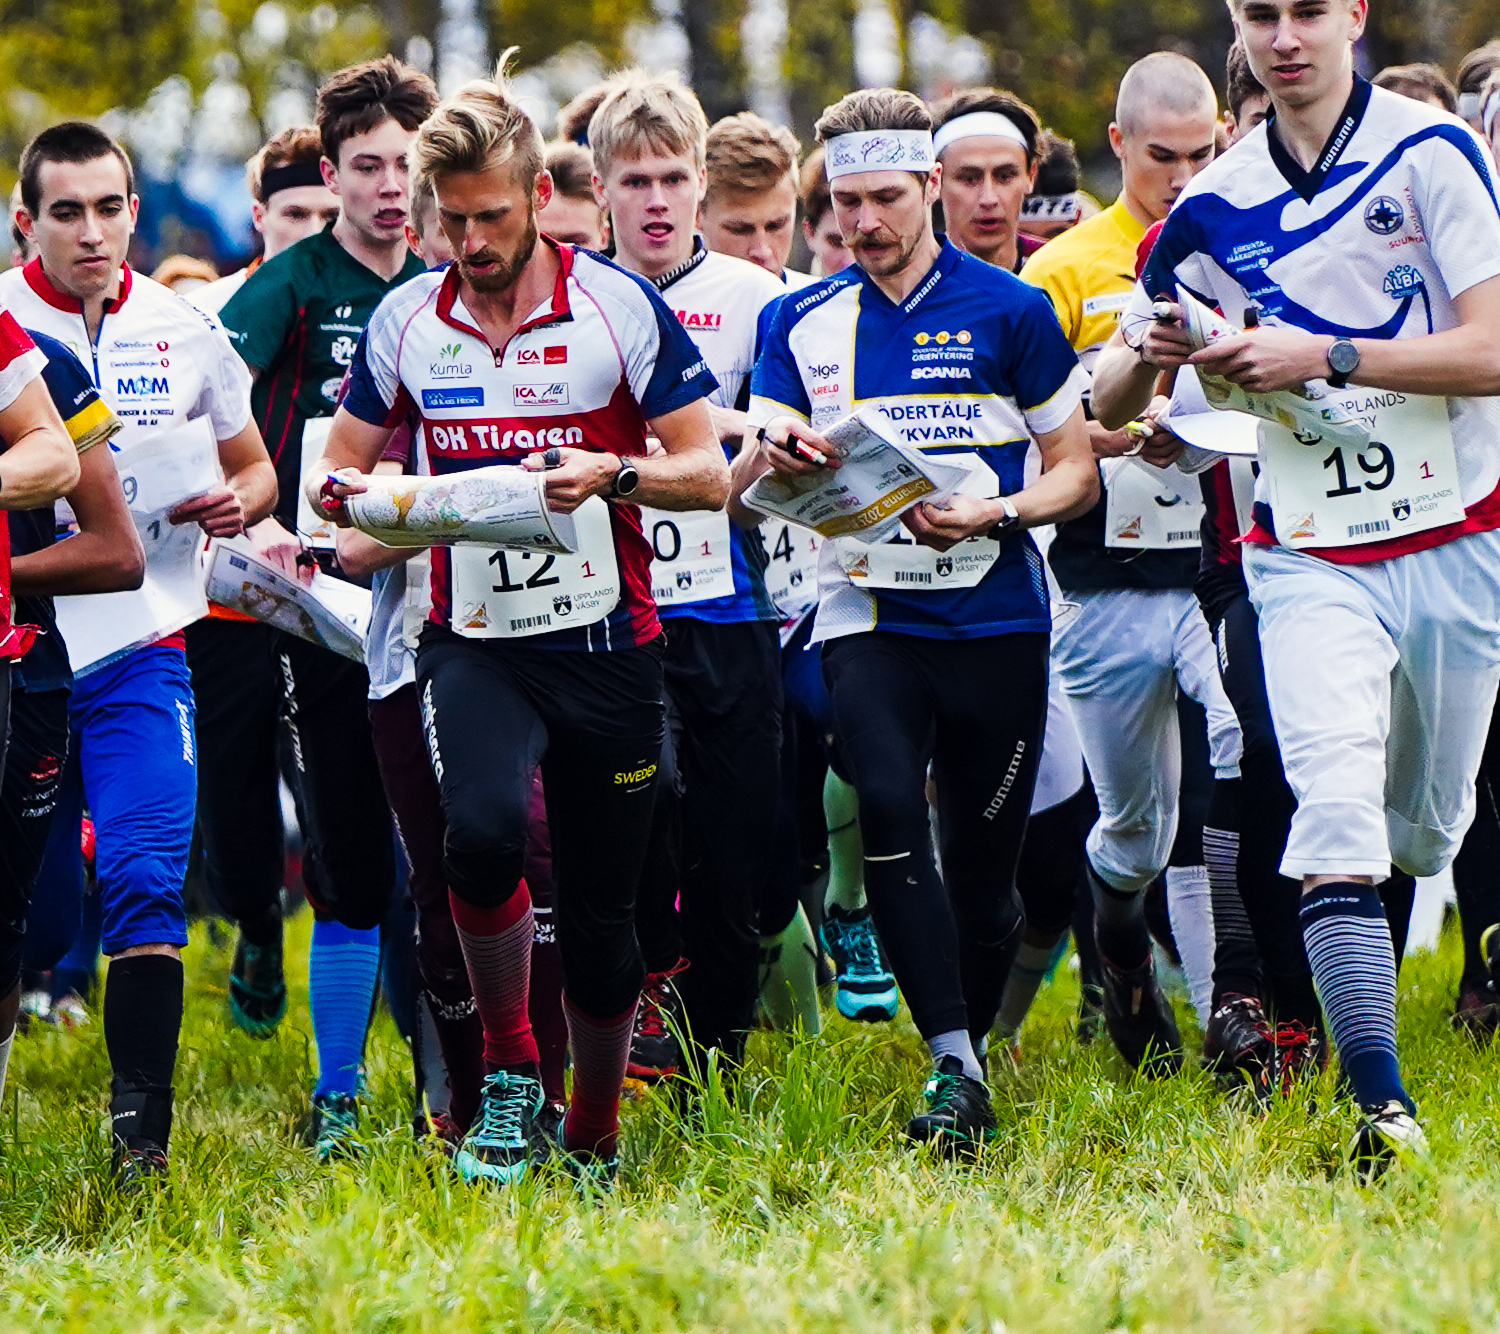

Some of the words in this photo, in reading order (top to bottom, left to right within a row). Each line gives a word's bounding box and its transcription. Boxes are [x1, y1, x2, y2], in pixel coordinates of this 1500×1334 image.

[1320, 116, 1354, 172] noname
[1383, 268, 1425, 293] ALBA
[905, 270, 942, 313] noname
[517, 350, 540, 360] ICA
[429, 363, 472, 375] Kumla
[808, 364, 839, 379] elge
[911, 367, 972, 380] SCANIA
[516, 388, 537, 398] ICA
[1340, 392, 1406, 412] PLANDS
[878, 401, 982, 421] ÖDERTÄLJE
[432, 426, 468, 451] OK
[471, 425, 583, 450] Tisaren
[901, 426, 974, 442] KVARN
[1323, 442, 1394, 498] 19
[1420, 461, 1434, 479] 1
[701, 540, 712, 555] 1
[762, 525, 795, 563] 4
[489, 550, 559, 592] 12
[581, 561, 595, 578] 1
[573, 587, 613, 602] UPPLANDS
[615, 764, 657, 784] SWEDEN
[983, 741, 1025, 821] noname
